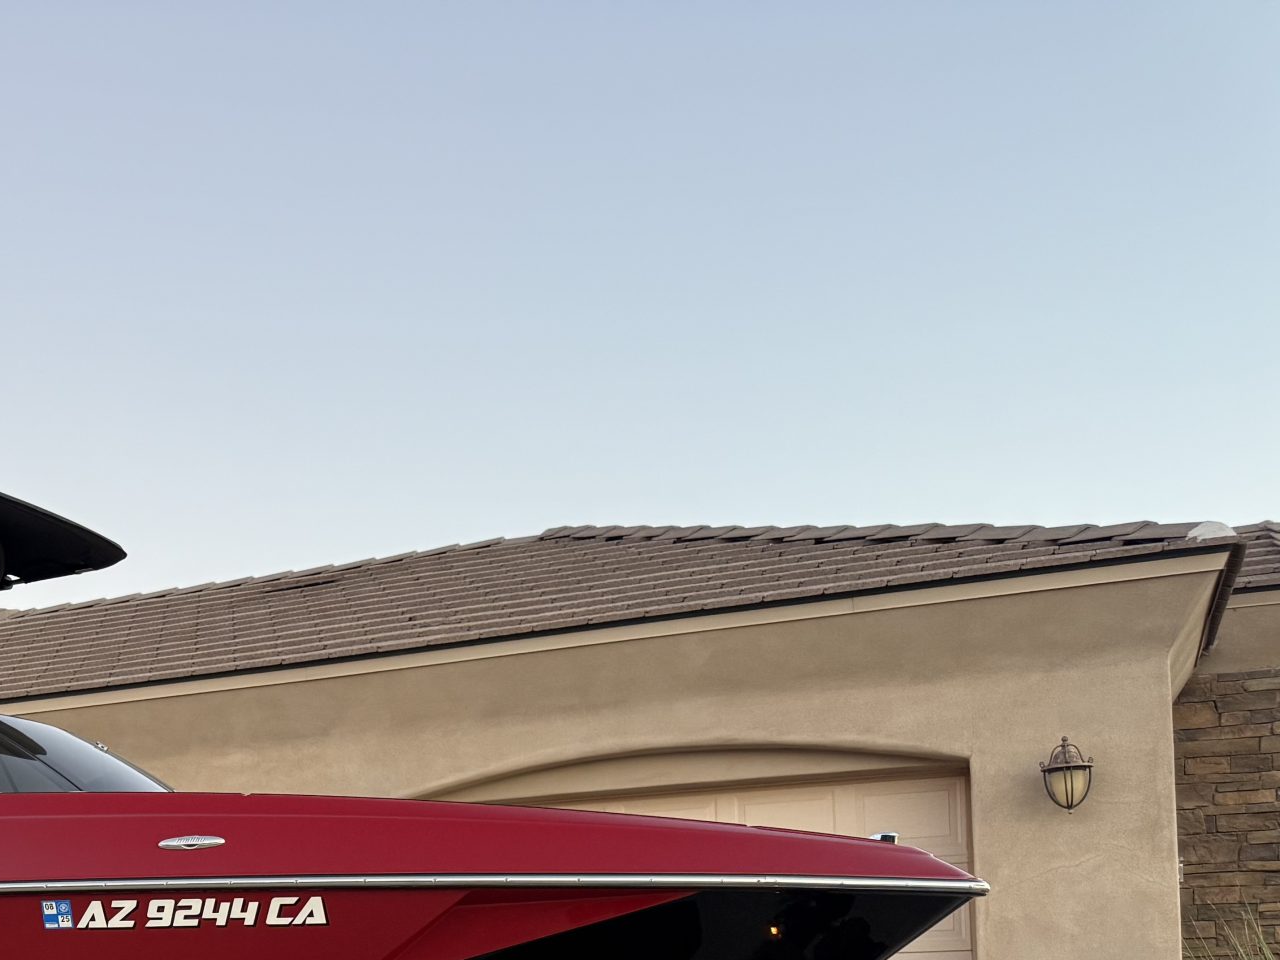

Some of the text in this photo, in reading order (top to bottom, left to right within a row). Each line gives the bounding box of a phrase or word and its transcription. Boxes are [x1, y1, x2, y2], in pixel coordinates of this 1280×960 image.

[60, 915, 71, 923] 25
[76, 896, 328, 929] AZ 9244 CA
